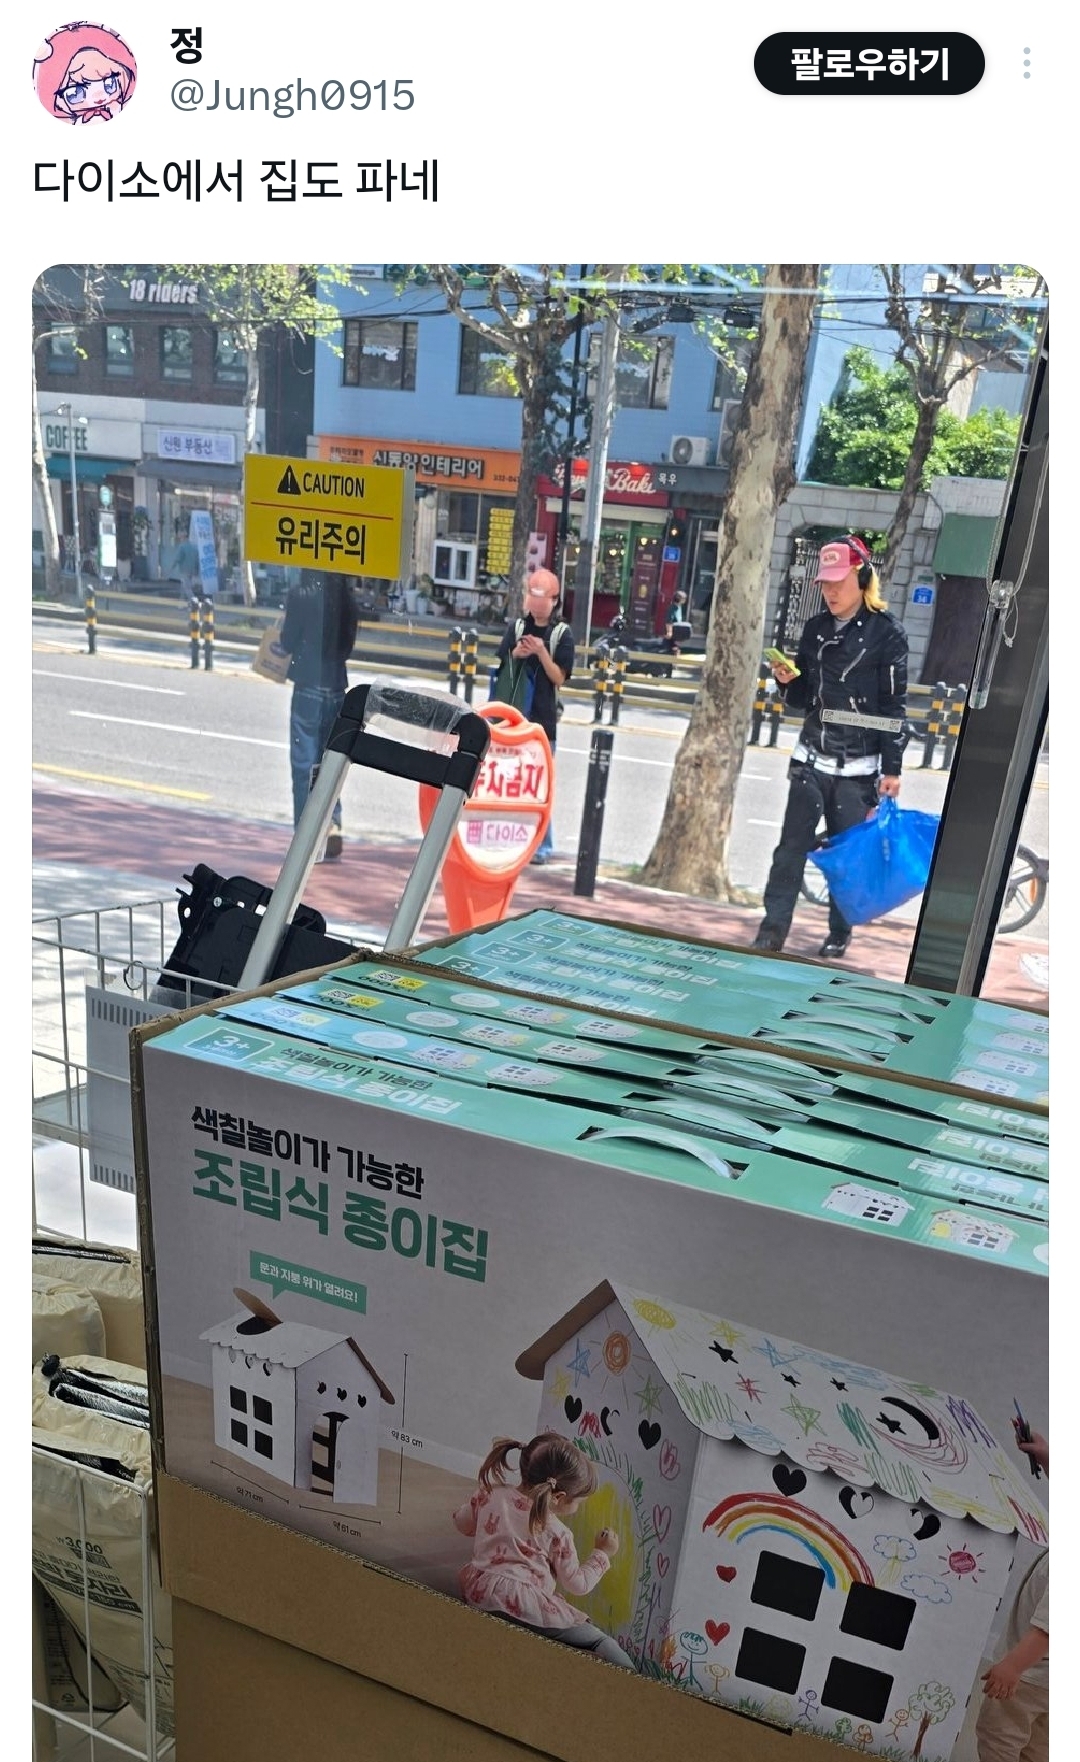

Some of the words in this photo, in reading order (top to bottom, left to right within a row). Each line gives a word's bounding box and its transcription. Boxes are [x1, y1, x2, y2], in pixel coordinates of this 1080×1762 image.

[130, 279, 146, 301] 18
[46, 424, 88, 450] COFEE
[303, 472, 365, 498] CAUTION
[275, 516, 366, 566] 유리주의
[486, 824, 528, 842] 다이소
[191, 1105, 331, 1174] 색칠놀이가
[336, 1145, 425, 1200] 가능한
[192, 1148, 330, 1237] 조립식
[342, 1191, 489, 1284] 종이집
[259, 1261, 280, 1279] 문과
[280, 1267, 301, 1286] 지붕
[302, 1273, 323, 1292] 위가
[323, 1281, 359, 1304] 열려요!
[400, 1433, 411, 1444] 83
[411, 1439, 424, 1449] cm
[252, 1493, 264, 1503] cm
[341, 1523, 350, 1534] 61
[350, 1528, 362, 1538] cm
